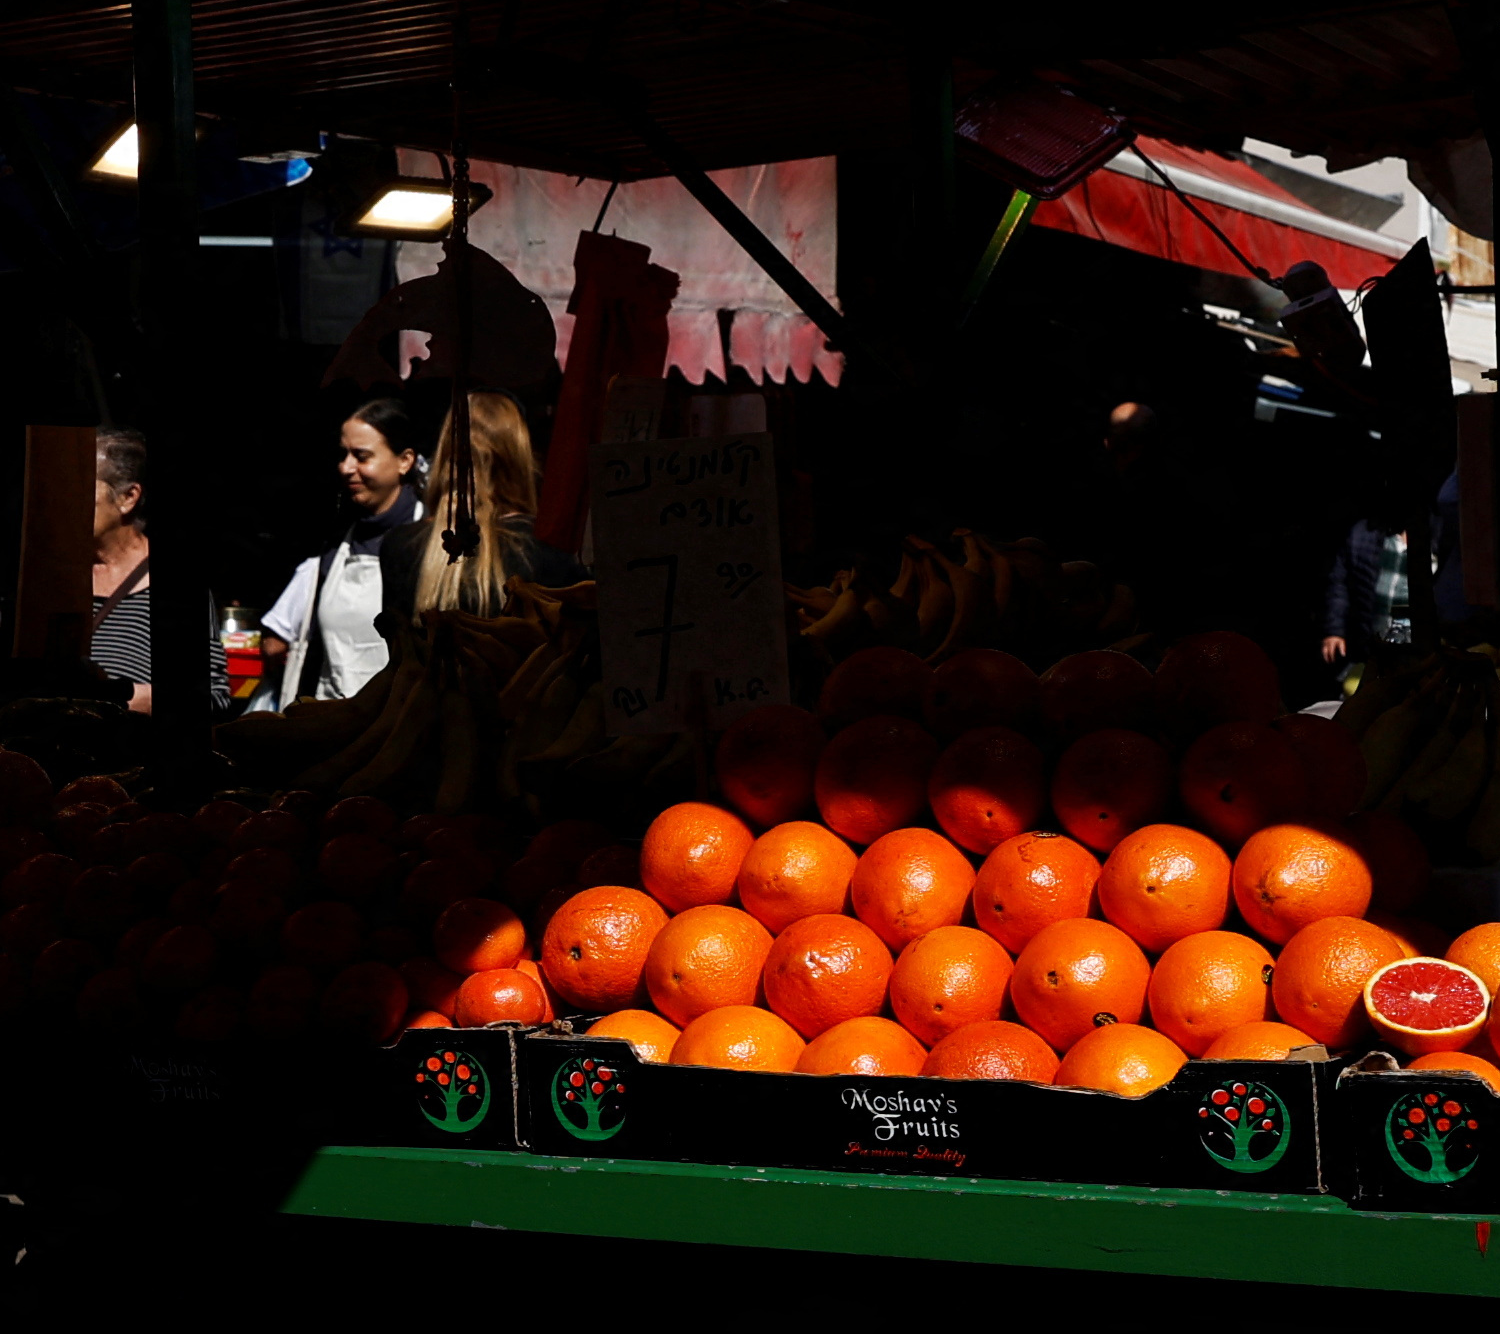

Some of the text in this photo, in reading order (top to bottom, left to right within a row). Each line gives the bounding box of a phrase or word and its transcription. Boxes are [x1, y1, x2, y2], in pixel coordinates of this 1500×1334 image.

[605, 440, 760, 498] קלמנטינה
[660, 496, 753, 528] אודם
[627, 554, 695, 702] 7
[841, 1088, 958, 1115] Moshav's
[872, 1114, 961, 1141] Fruits
